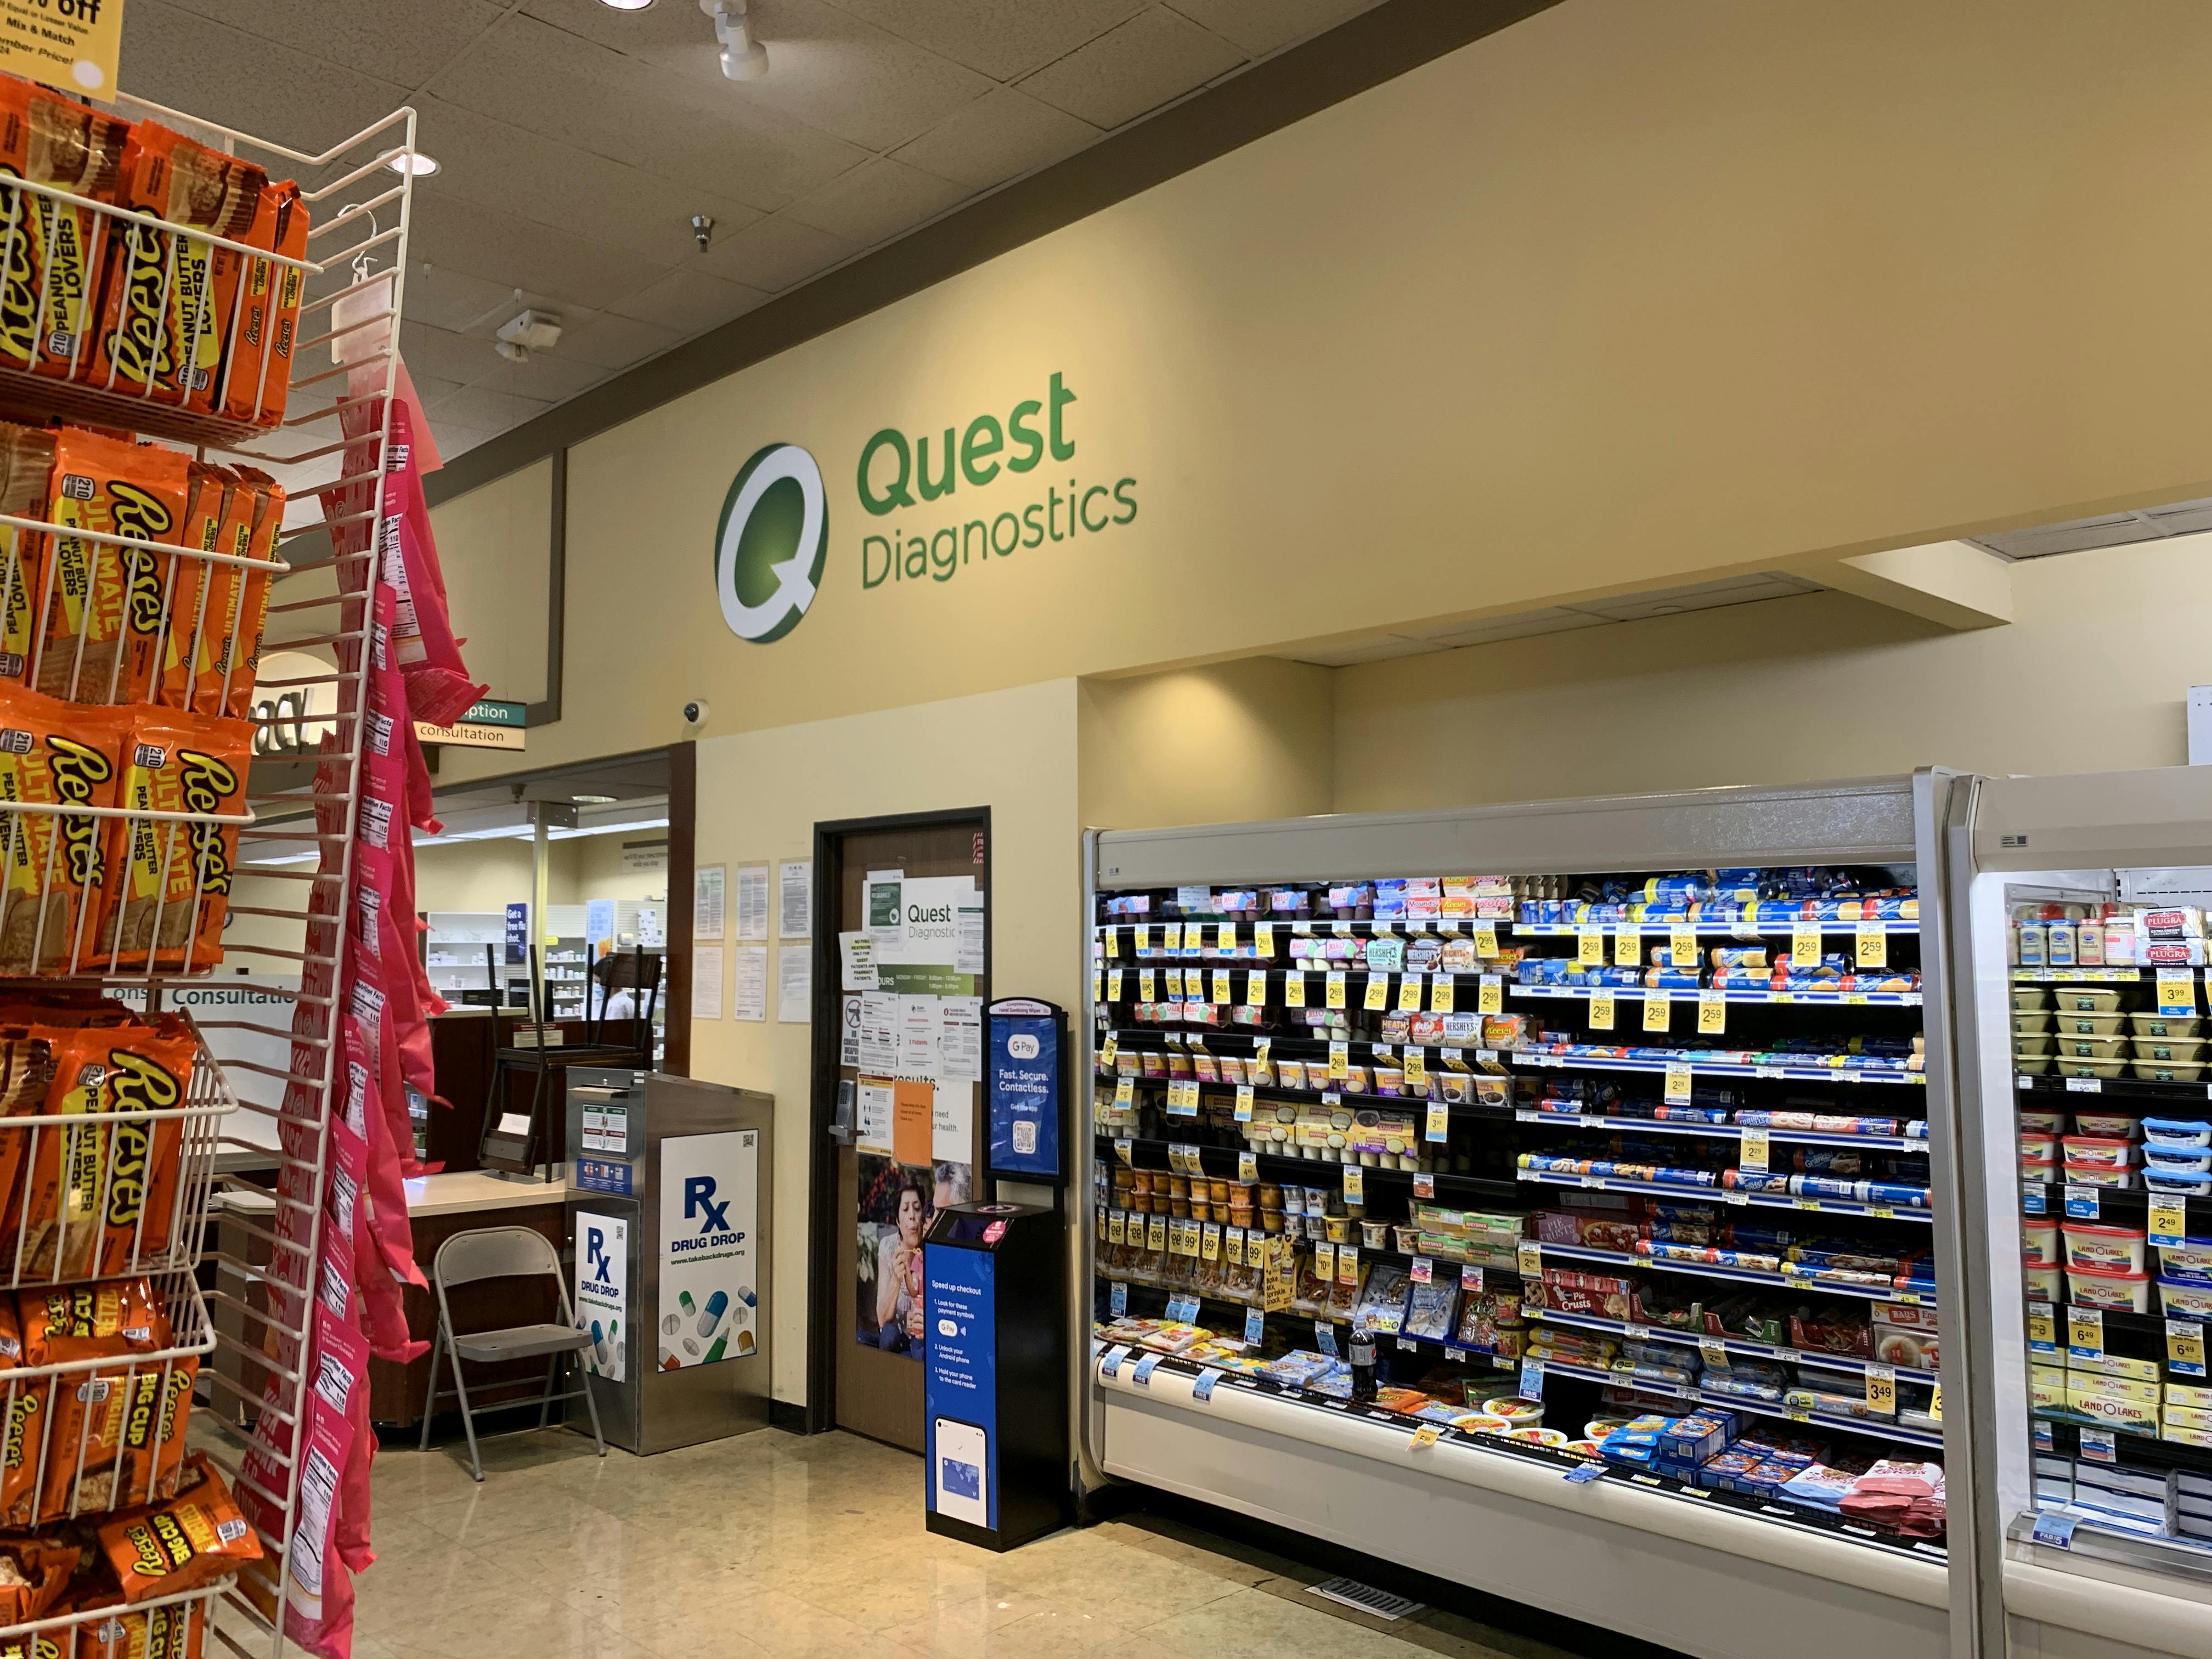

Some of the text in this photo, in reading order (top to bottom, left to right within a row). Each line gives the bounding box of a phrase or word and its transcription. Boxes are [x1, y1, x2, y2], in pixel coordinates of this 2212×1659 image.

[7, 17, 75, 46] Mix & Match
[67, 21, 89, 35] Value
[38, 47, 74, 65] Price!
[58, 218, 83, 298] LOVERS
[52, 333, 67, 355] 210
[857, 371, 1077, 516] Quest
[77, 477, 91, 499] 210
[862, 478, 1138, 590] Diagnostics
[59, 541, 78, 596] LOVERS
[223, 574, 241, 634] ULTIMATE
[420, 725, 504, 741] consultation
[14, 732, 30, 752] 210
[379, 738, 388, 747] 110
[149, 748, 162, 767] 210
[378, 825, 388, 834] 110
[143, 831, 159, 875] BUTTER
[507, 909, 517, 919] Get
[908, 904, 951, 923] Quest
[506, 922, 518, 932] free
[2148, 916, 2182, 926] PLUGRÁ
[506, 933, 521, 943] shot.
[1582, 942, 1599, 955] 259
[1620, 942, 1637, 955] 259
[1675, 942, 1693, 956] 259
[2150, 950, 2187, 958] PLUGRÁ
[2168, 989, 2184, 1000] 399
[370, 1013, 380, 1023] 110
[1382, 1019, 1406, 1029] HEATH
[1013, 1041, 1035, 1054] G Pay
[999, 1069, 1049, 1081] Fast. Secure.
[999, 1081, 1049, 1093] Contactless.
[939, 1124, 959, 1132] health.
[80, 1154, 97, 1212] BUTTER
[1547, 1217, 1563, 1232] PIE
[2158, 1217, 2176, 1229] 249
[671, 1232, 746, 1252] DRUG DROP
[670, 1249, 745, 1265] www.takebackdrugs.org
[2078, 1245, 2095, 1254] LAND
[2106, 1248, 2124, 1257] LAKES
[2168, 1254, 2185, 1262] LAND
[582, 1280, 619, 1297] DRUG DROP
[932, 1279, 981, 1296] Speed up checkout
[2079, 1287, 2097, 1296] LAND
[2107, 1290, 2125, 1299] LAKES
[1573, 1291, 1585, 1300] Pie
[579, 1296, 622, 1312] www.takebackdrugs.org
[955, 1302, 968, 1311] these
[1561, 1300, 1592, 1312] Crusts
[938, 1308, 975, 1319] payment symbols
[1892, 1310, 1916, 1321] BAYS
[941, 1323, 955, 1334] G Pay
[2078, 1330, 2094, 1341] 649
[938, 1344, 953, 1352] Unlock
[2177, 1344, 2194, 1356] 649
[939, 1352, 970, 1364] Android phone
[321, 1352, 353, 1385] Nutrition Facts
[949, 1370, 959, 1379] your
[959, 1372, 973, 1381] phone
[952, 1378, 962, 1386] card
[962, 1380, 977, 1390] reader
[2092, 1379, 2108, 1388] LAND
[2115, 1383, 2131, 1391] LAKES
[1869, 1384, 1892, 1401] 349
[2194, 1392, 2210, 1400] LAND
[127, 1373, 157, 1446] BIG CUP
[2079, 1400, 2102, 1413] LAND
[2117, 1408, 2143, 1420] LAKES
[311, 1448, 328, 1469] Nutrition
[154, 1515, 191, 1566] BIG CUP
[2040, 1532, 2053, 1541] FAB
